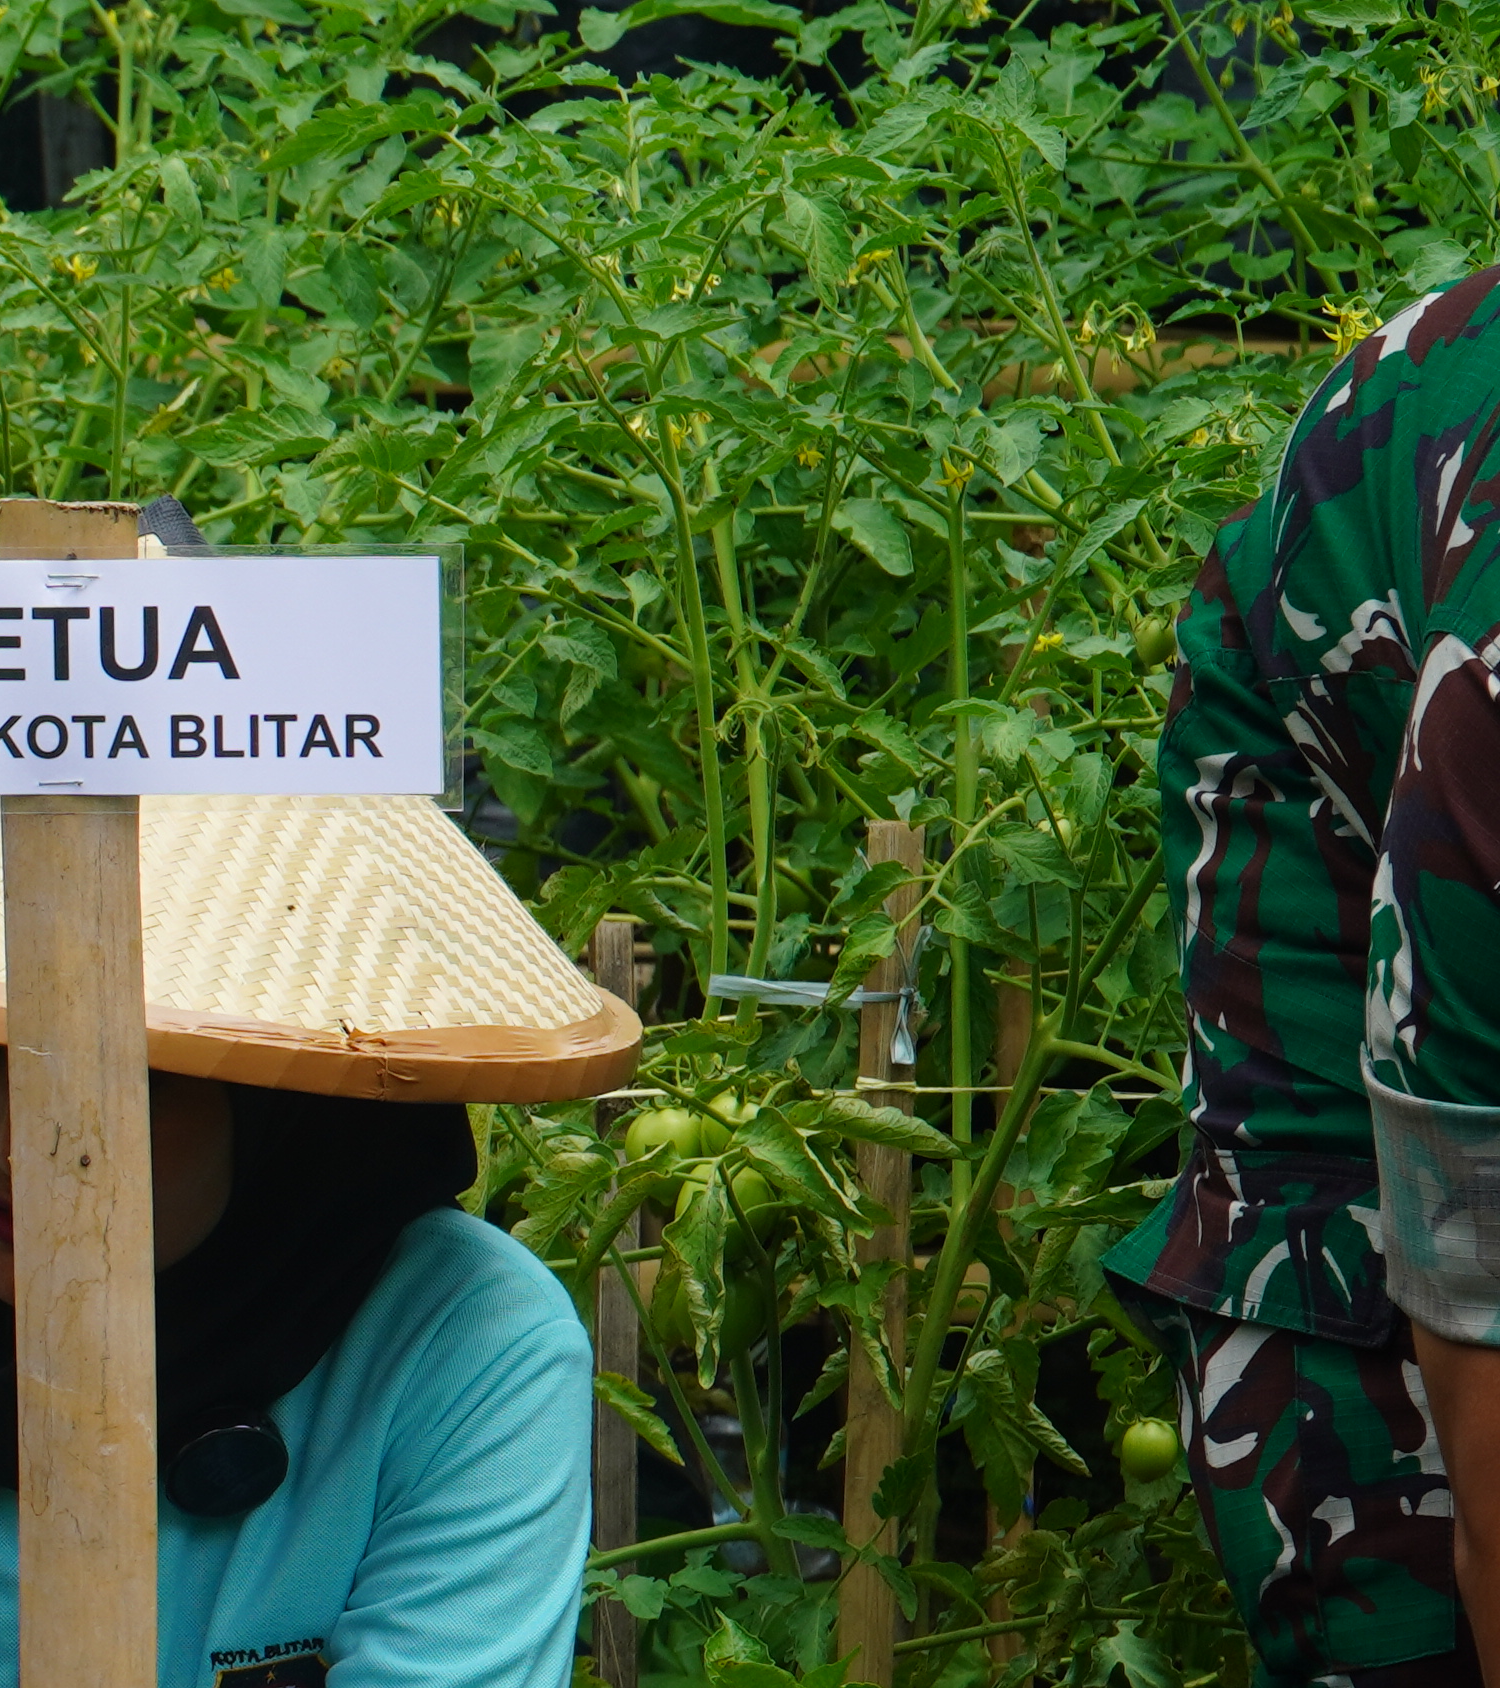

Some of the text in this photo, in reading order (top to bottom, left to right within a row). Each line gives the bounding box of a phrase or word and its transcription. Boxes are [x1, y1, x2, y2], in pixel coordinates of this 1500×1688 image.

[169, 713, 384, 760] BLITAR
[211, 1638, 325, 1668] KOTA BLITAR
